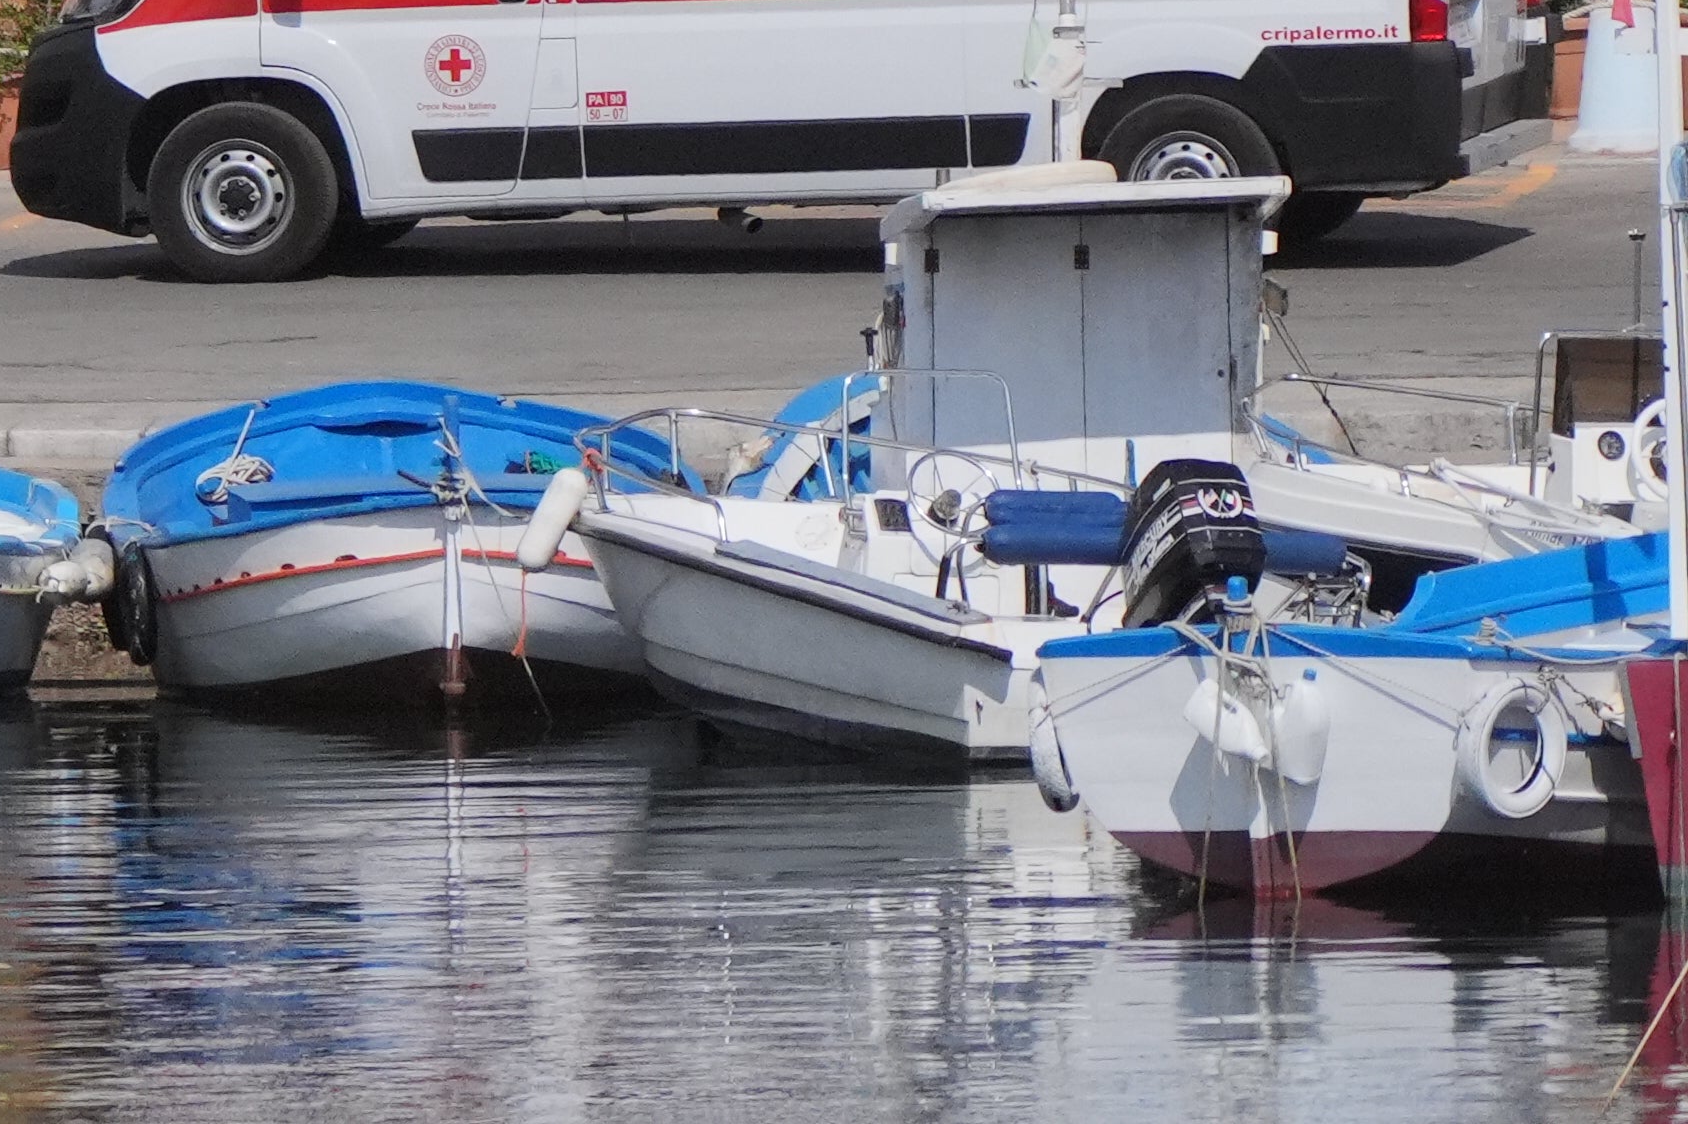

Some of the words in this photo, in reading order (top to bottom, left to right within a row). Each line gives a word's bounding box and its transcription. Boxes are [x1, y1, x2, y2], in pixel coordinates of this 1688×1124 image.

[1260, 24, 1399, 43] cripalermo.it
[587, 94, 605, 106] PA
[612, 107, 625, 120] 07
